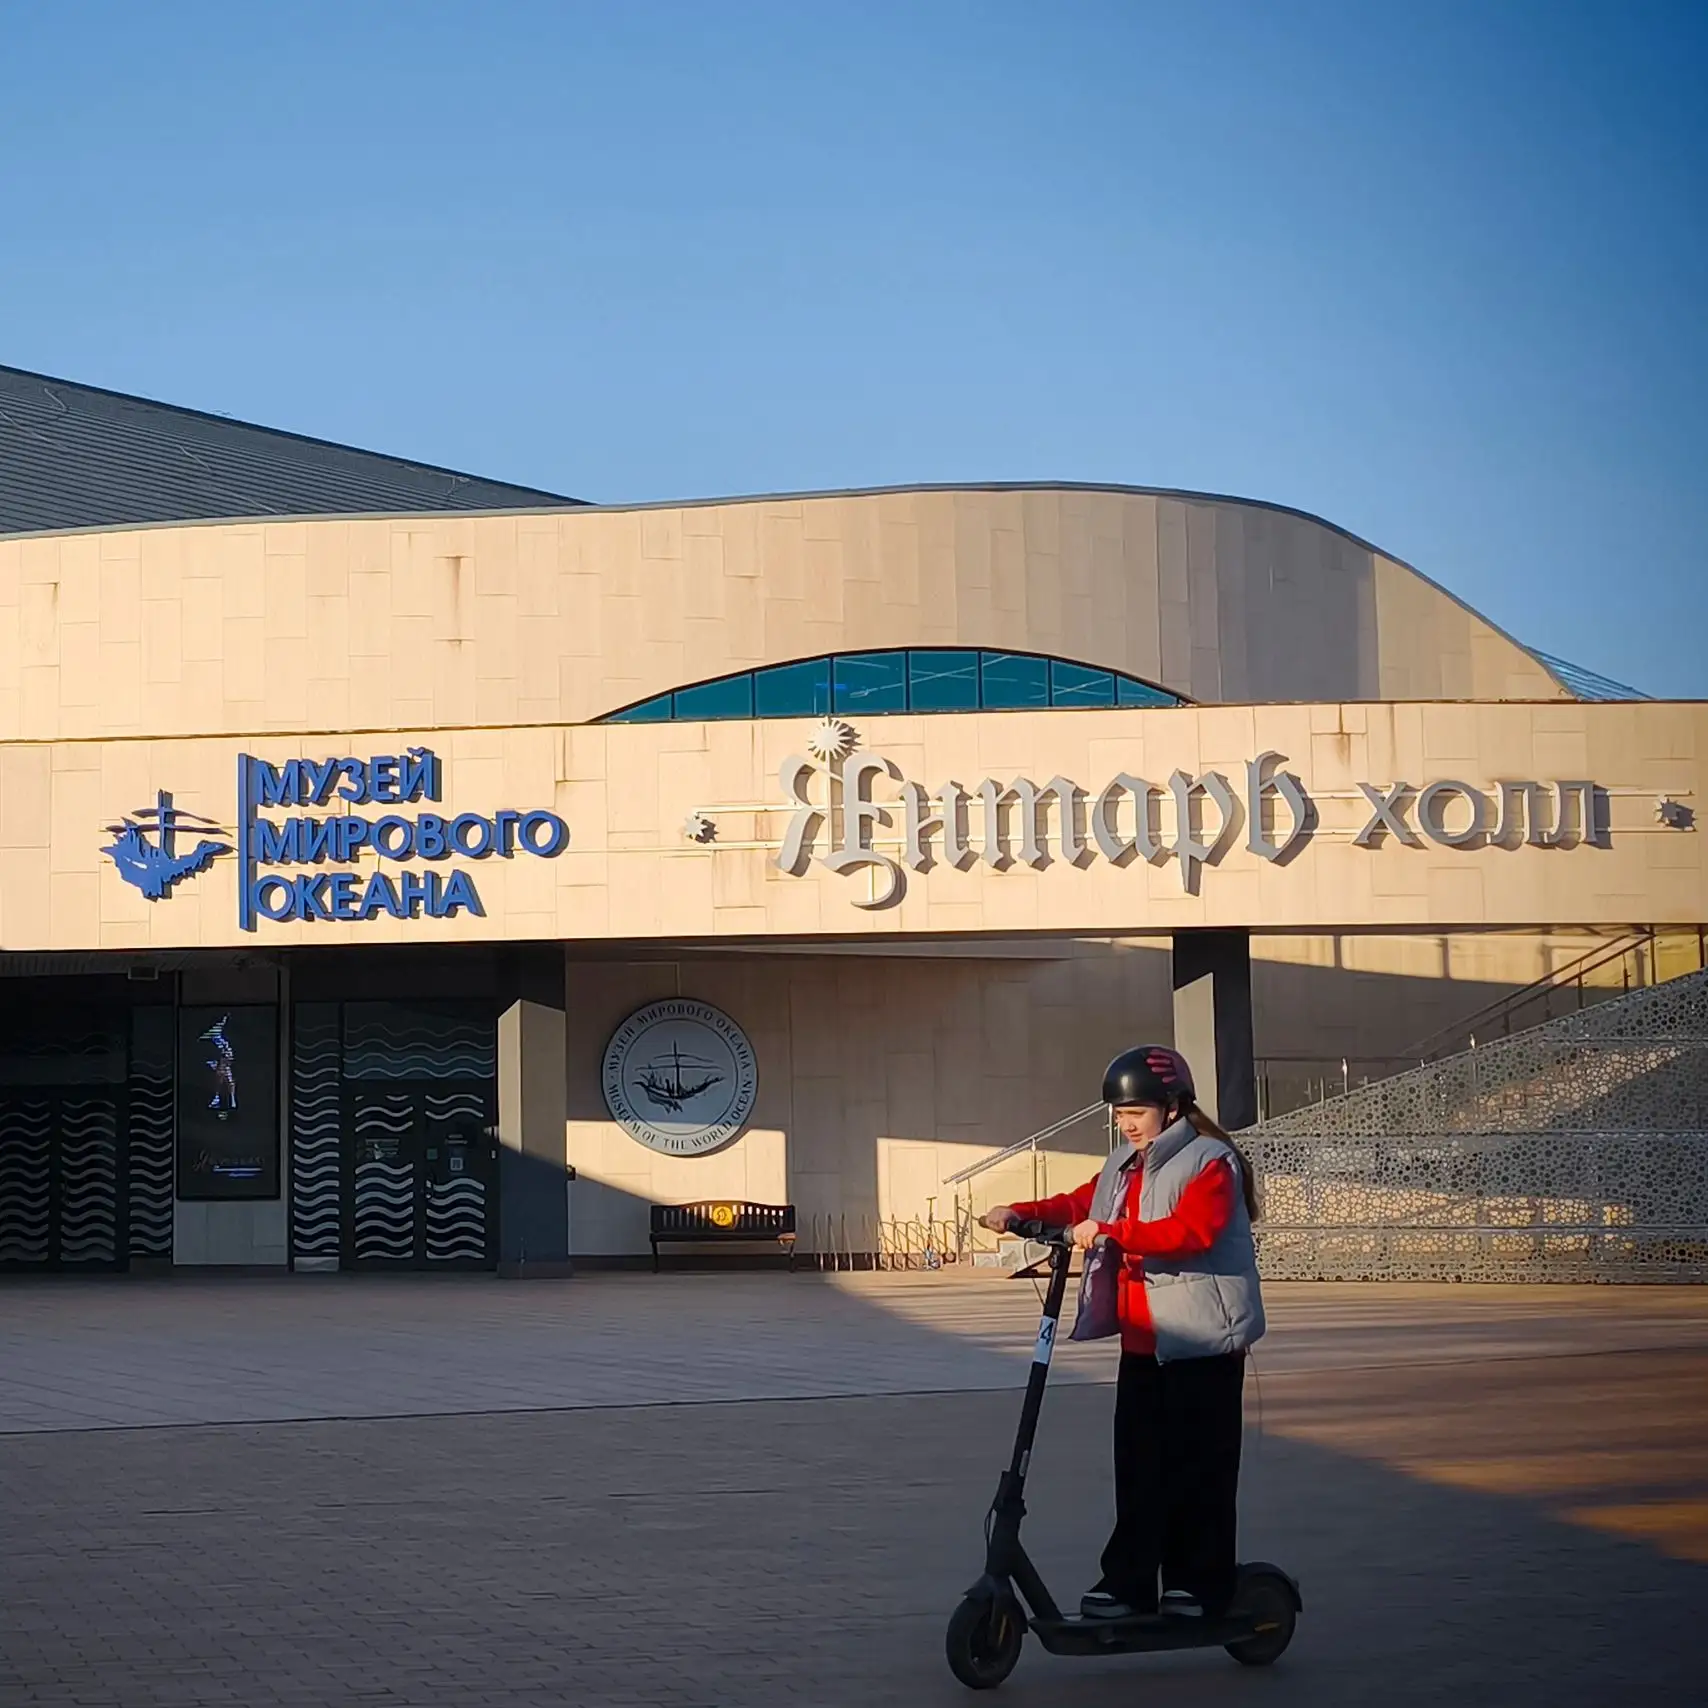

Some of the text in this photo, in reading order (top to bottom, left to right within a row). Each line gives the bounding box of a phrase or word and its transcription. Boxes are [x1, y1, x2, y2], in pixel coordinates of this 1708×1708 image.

[254, 747, 440, 805] МУЗЕЙ
[254, 810, 569, 864] МИРОВОГО
[777, 750, 1608, 910] Янтарь холл
[253, 869, 485, 920] ОКЕАНА
[636, 1003, 714, 1025] МИРОВОГО
[716, 1018, 751, 1070] ОКЕАНА
[608, 1080, 753, 1150] MUSEUM OF THE WORLD OCEAN
[1040, 1321, 1054, 1345] 4
